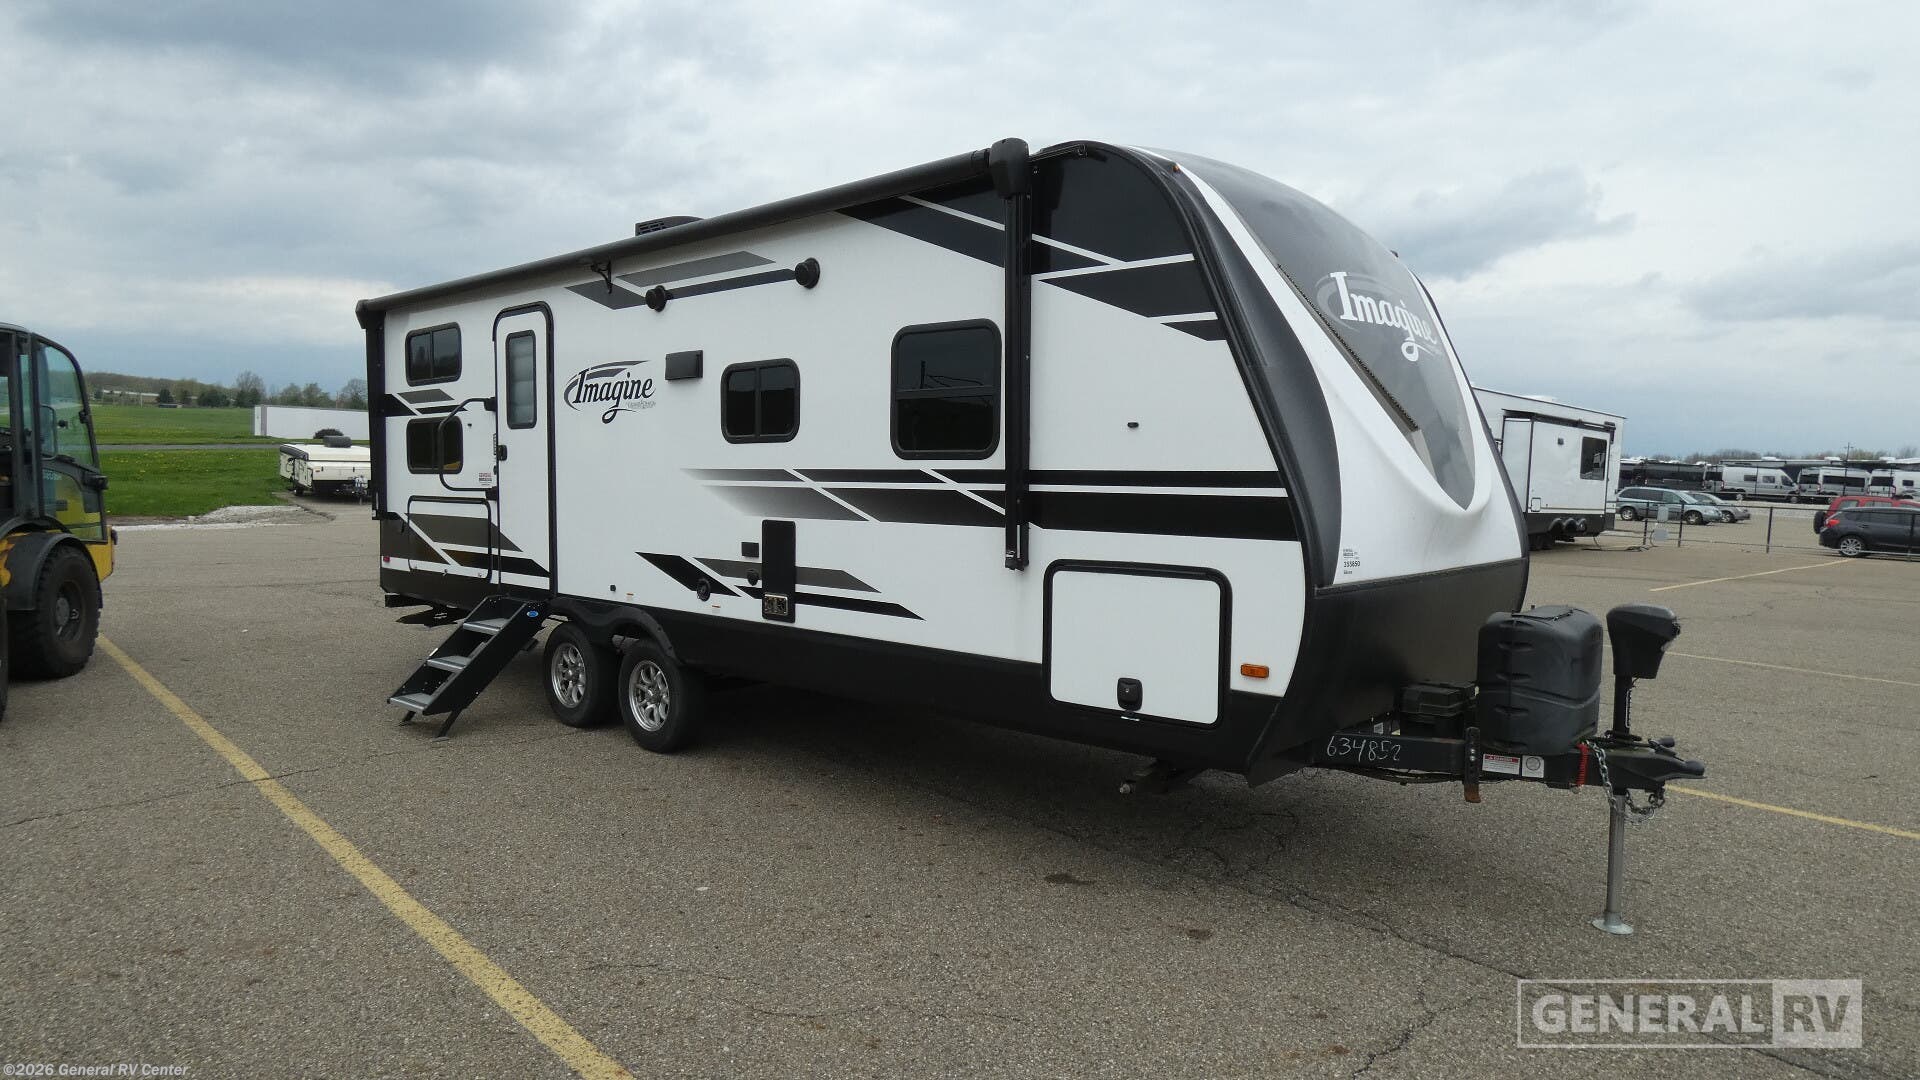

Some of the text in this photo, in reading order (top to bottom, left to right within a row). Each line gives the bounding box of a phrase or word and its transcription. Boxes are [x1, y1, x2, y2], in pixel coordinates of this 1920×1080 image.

[1329, 271, 1438, 362] Imagine
[571, 367, 657, 425] Imagine
[1326, 735, 1401, 762] 634852
